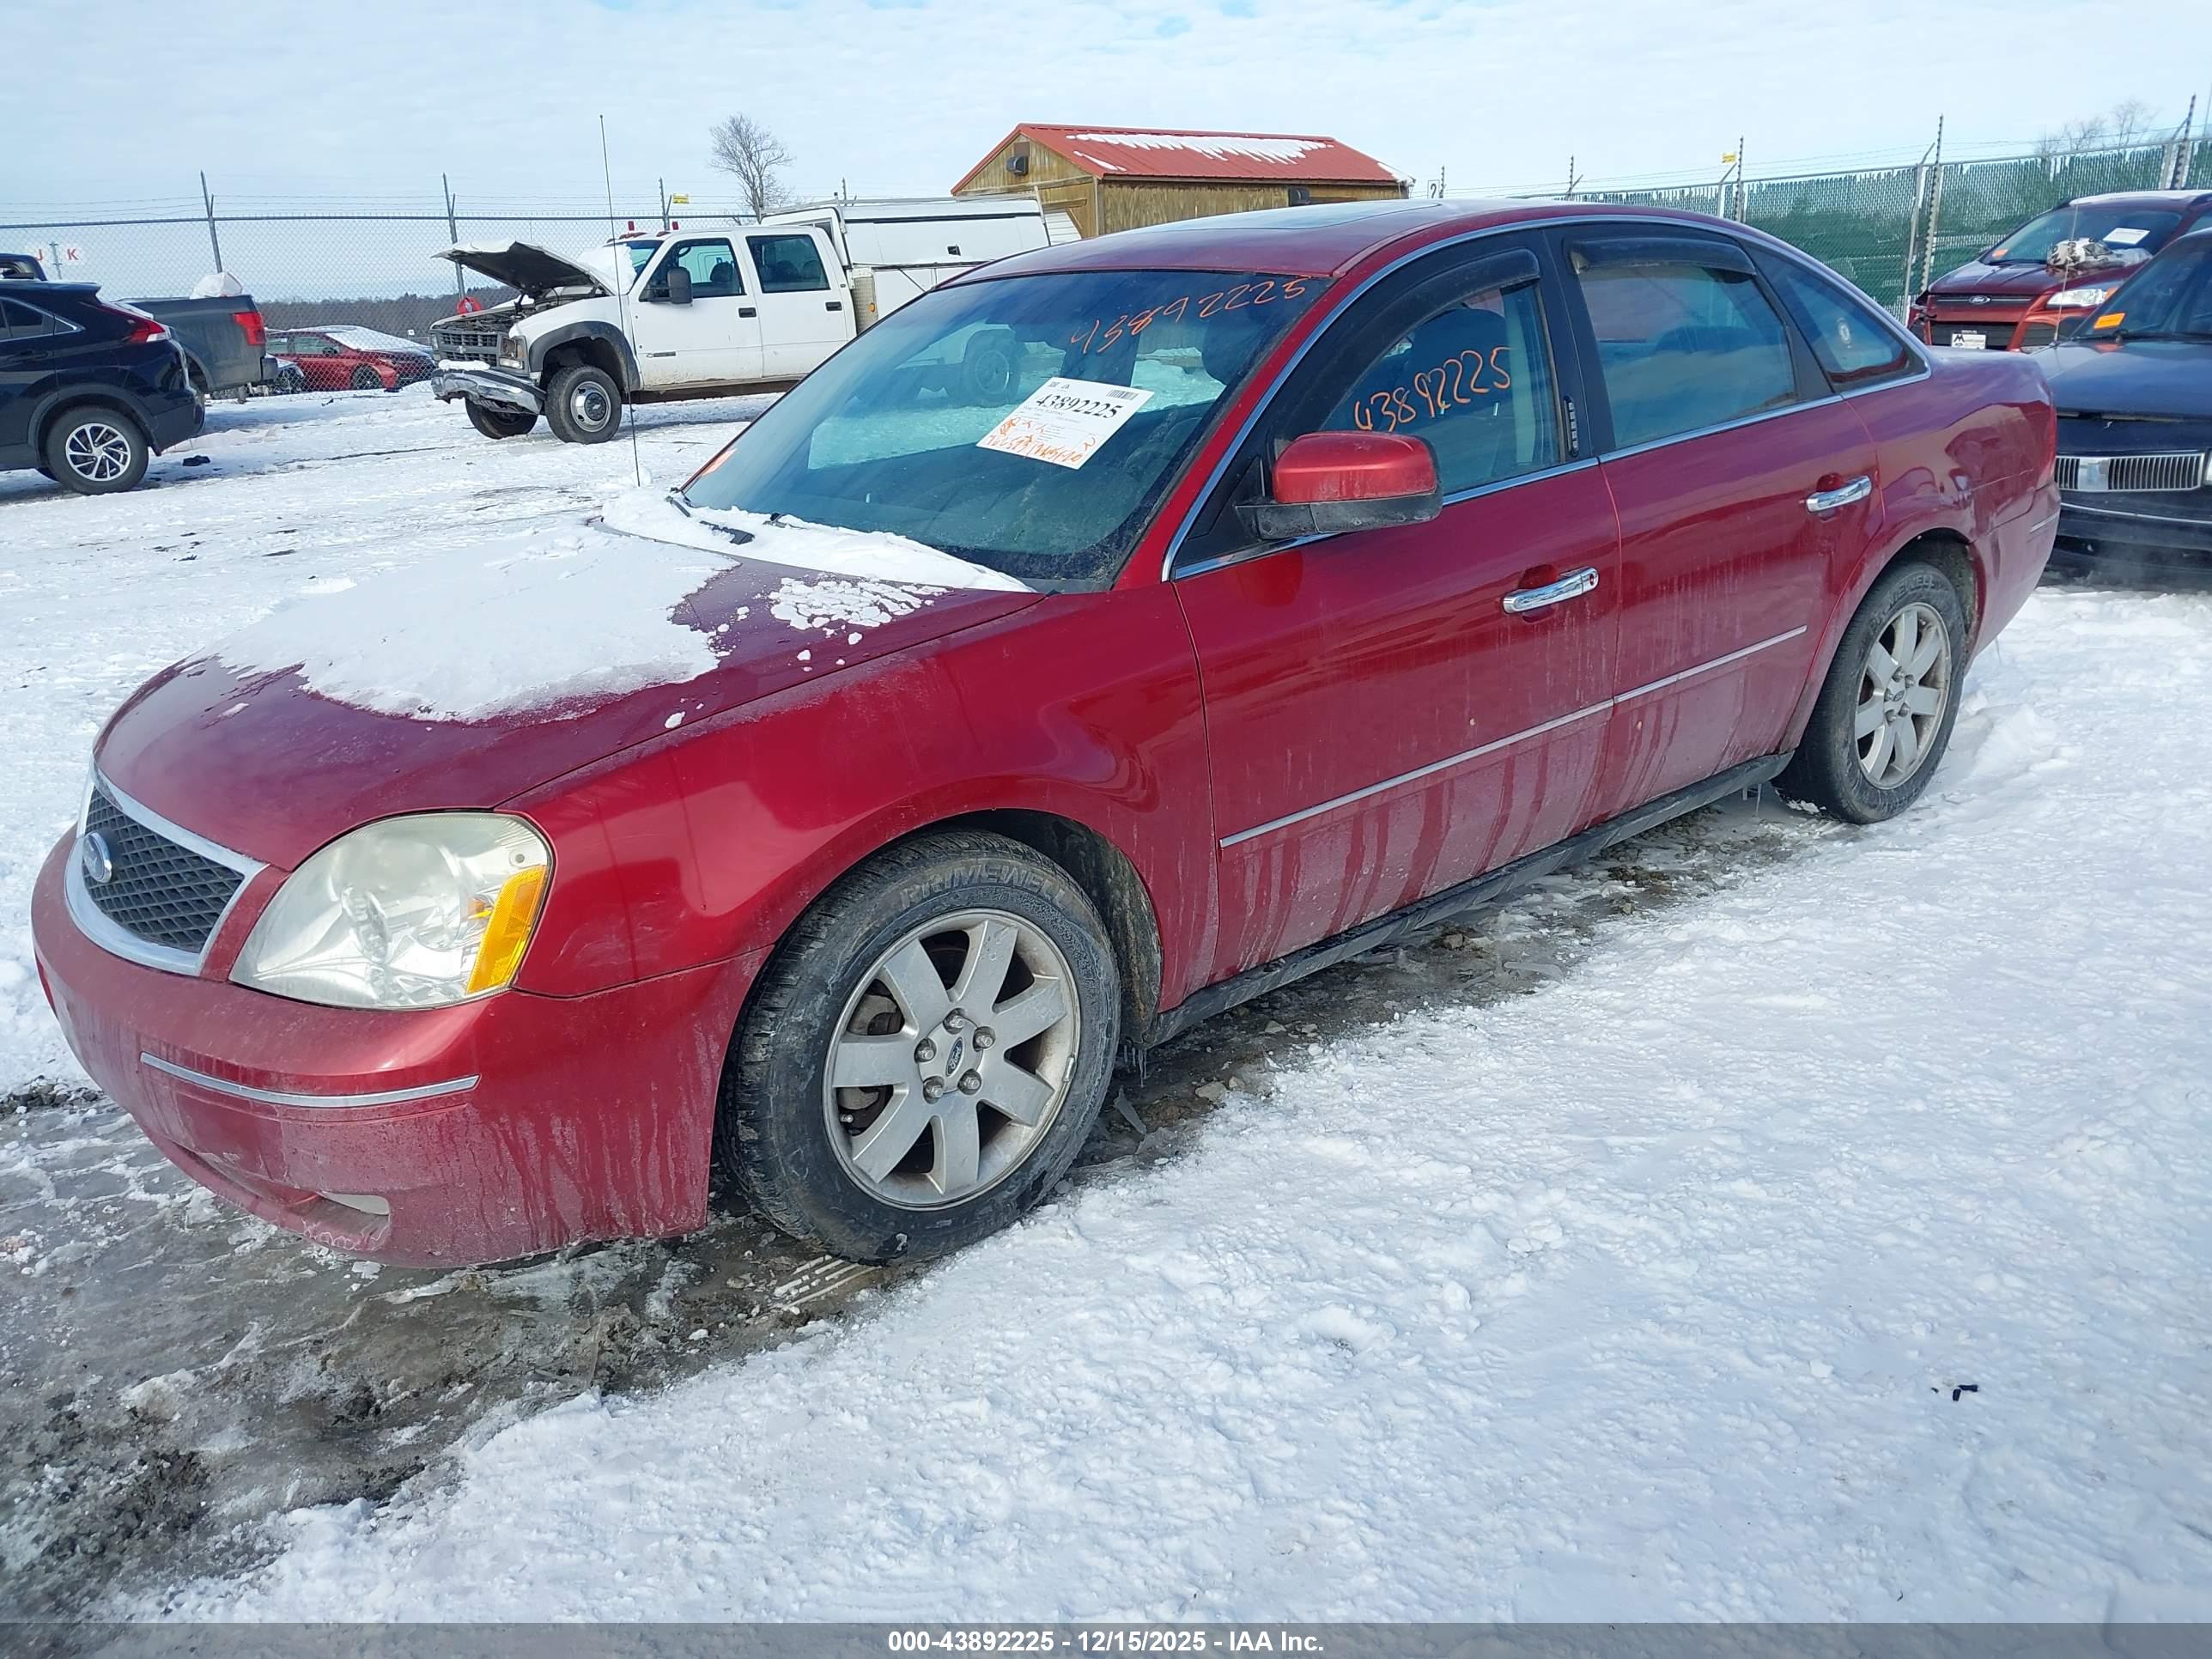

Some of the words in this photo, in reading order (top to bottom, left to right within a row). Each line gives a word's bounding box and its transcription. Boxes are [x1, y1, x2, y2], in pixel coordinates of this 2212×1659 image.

[67, 248, 79, 261] K
[1070, 275, 1311, 355] 43892225
[1036, 393, 1125, 419] 43892225
[1354, 346, 1513, 433] 43892225
